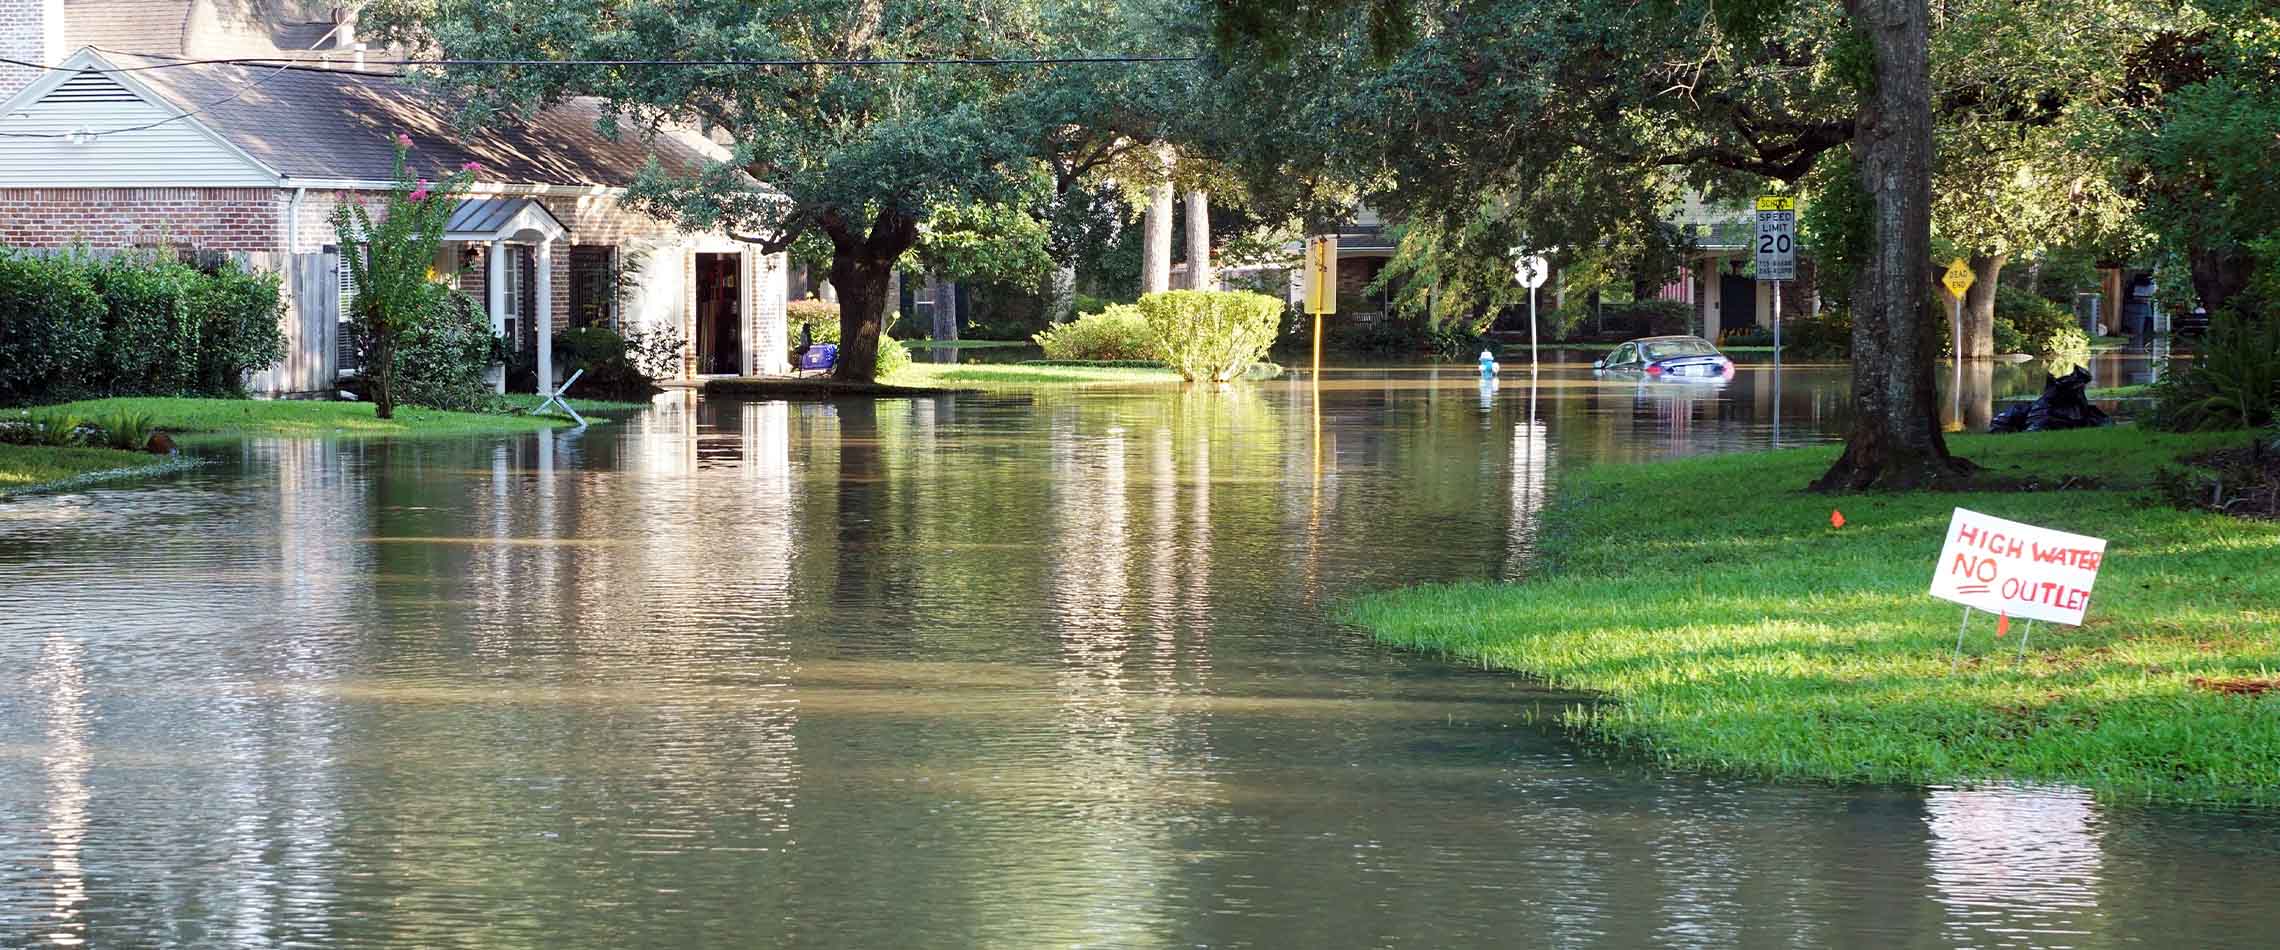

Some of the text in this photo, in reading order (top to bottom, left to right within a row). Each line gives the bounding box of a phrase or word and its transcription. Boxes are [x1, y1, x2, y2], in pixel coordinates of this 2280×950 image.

[1759, 213, 1792, 221] SPEED
[1762, 224, 1787, 232] LIMIT
[1760, 234, 1791, 253] 20
[1949, 270, 1967, 278] DEAD
[1957, 523, 2102, 571] HIGH WATER
[1952, 552, 2090, 611] NO OUTLET
